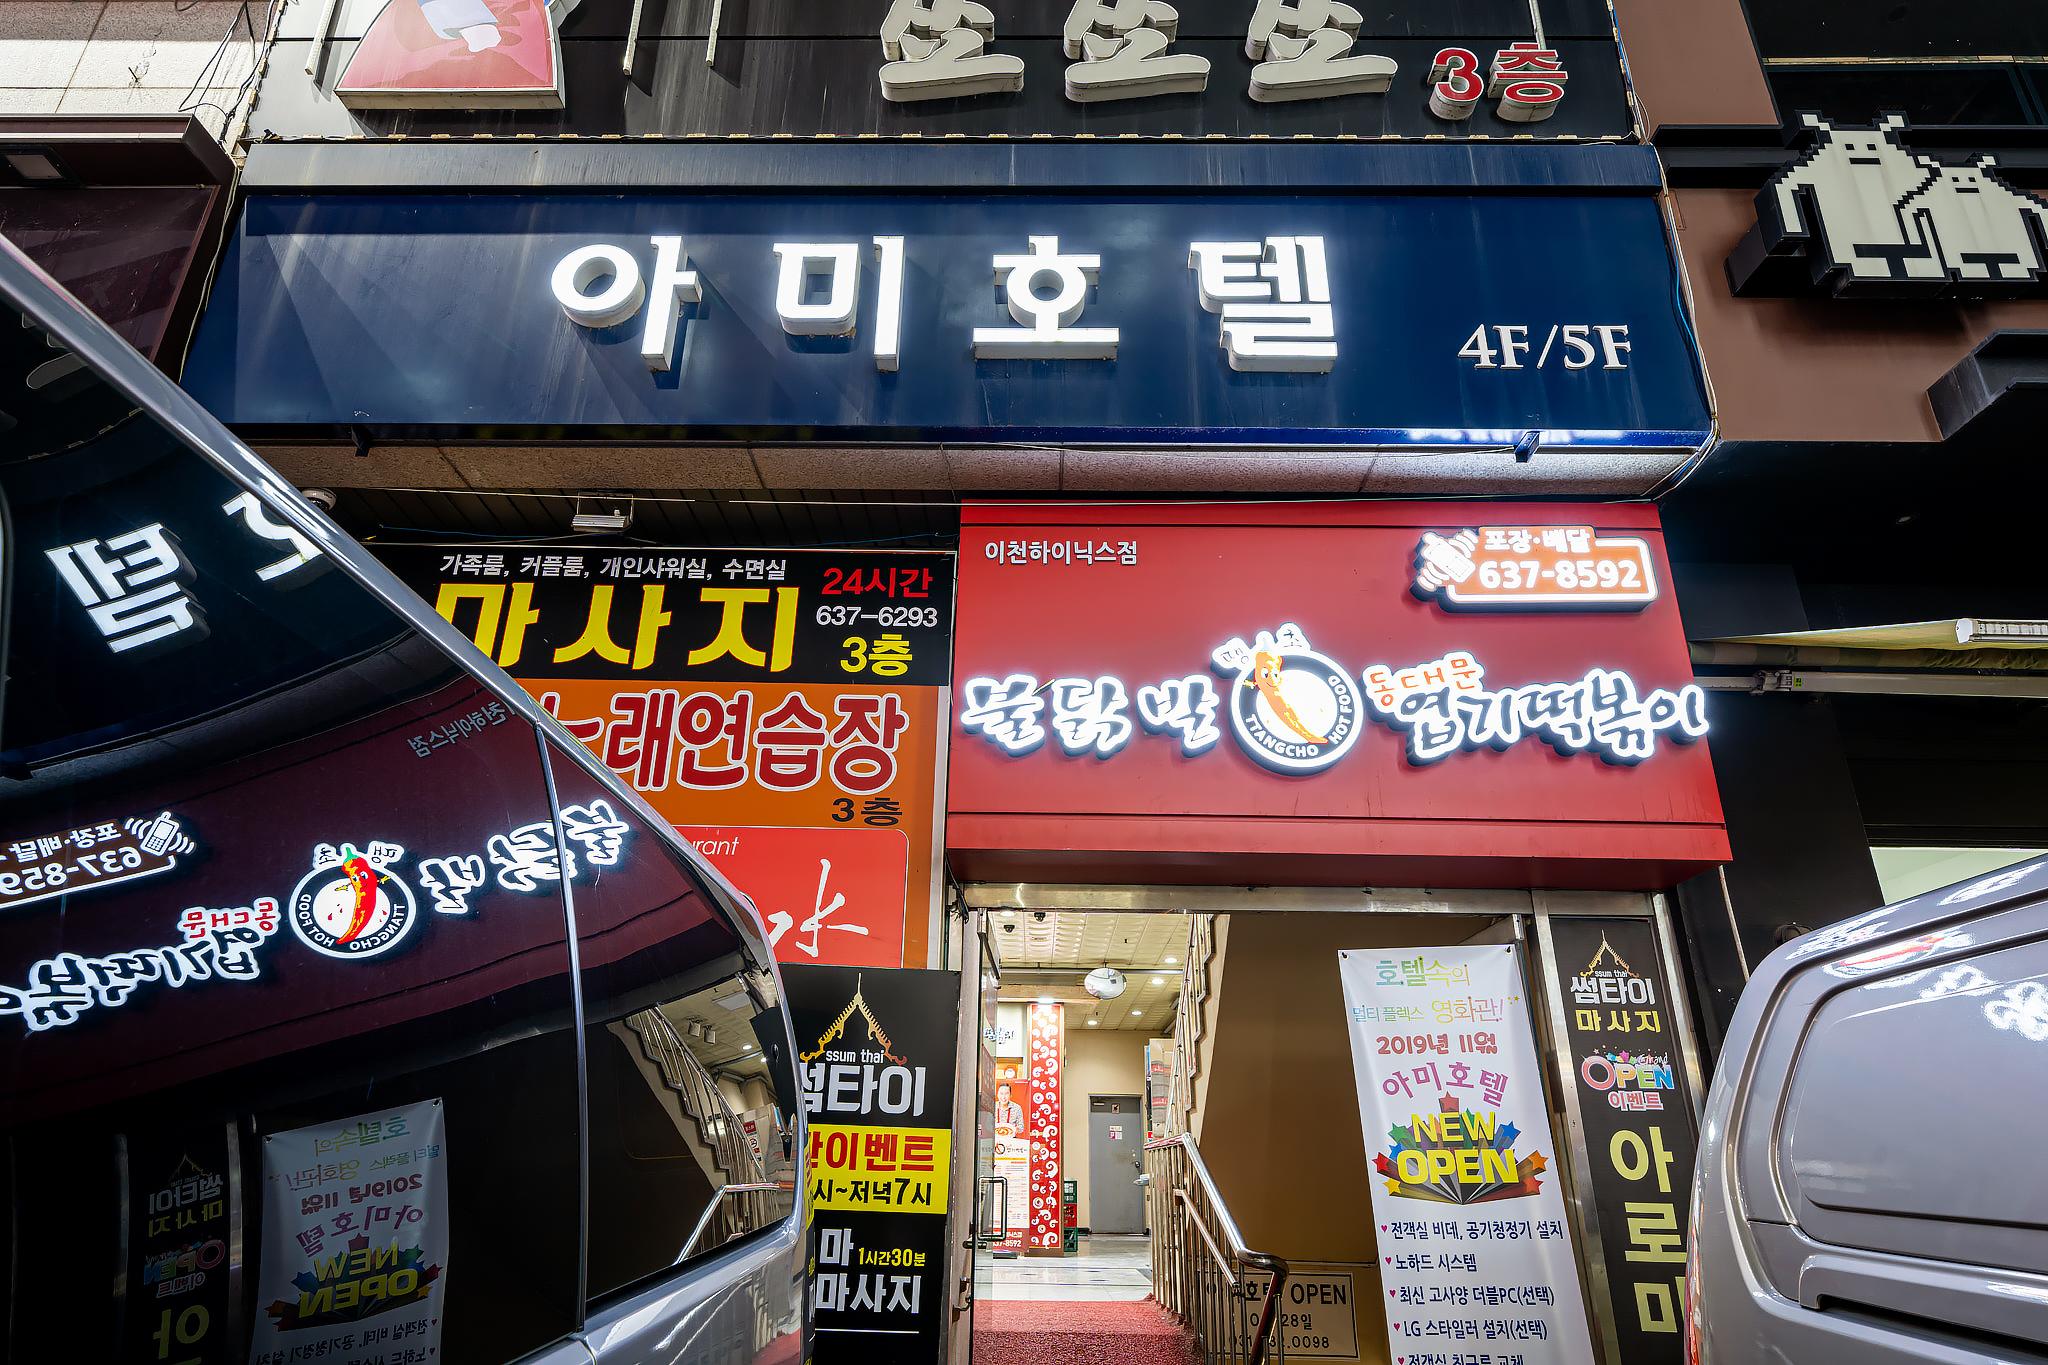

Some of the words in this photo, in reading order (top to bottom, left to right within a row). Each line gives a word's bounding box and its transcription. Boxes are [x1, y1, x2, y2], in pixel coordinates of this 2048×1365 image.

[1428, 42, 1568, 121] 3층
[551, 235, 1338, 373] 아미호텔
[1458, 324, 1632, 370] 4F/5F
[985, 541, 1137, 565] 이천하이닉스점
[1484, 528, 1590, 553] 포장·배달
[440, 554, 510, 577] 가족룸,
[519, 555, 590, 578] 커플룸,
[600, 557, 712, 580] 개인샤워실,
[722, 558, 786, 580] 수면실
[1479, 560, 1641, 588] 637-8592
[822, 567, 933, 598] 24시간
[435, 582, 799, 672] 마사지
[816, 605, 938, 627] 637-6293
[840, 633, 913, 677] 3층
[1328, 675, 1353, 714] FOOD
[1369, 658, 1477, 707] 동대문
[1399, 671, 1706, 756] 엽기떡볶이
[1246, 714, 1319, 758] TTANGCHO
[1329, 716, 1352, 744] HOT
[831, 798, 903, 827] 3층
[1376, 955, 1471, 987] 호텔속의
[1570, 976, 1656, 1005] 썸타이
[1575, 1009, 1661, 1033] 마사지
[825, 1050, 856, 1062] ssum
[860, 1048, 885, 1063] thai
[1376, 1033, 1449, 1055] 2019년
[1382, 1061, 1509, 1108] 아미호텔
[1581, 1055, 1674, 1091] OPEN
[1608, 1090, 1664, 1111] 이벤트
[1411, 1112, 1496, 1144] NEW
[1396, 1149, 1520, 1185] OPEN
[1391, 1221, 1428, 1240] 전객실
[1432, 1221, 1463, 1240] 비데,
[1466, 1220, 1532, 1240] 공기청정기
[1536, 1220, 1564, 1240] 설치
[858, 1247, 926, 1267] 1시간30분
[1395, 1254, 1434, 1272] 노하드
[1438, 1253, 1478, 1273] 시스템
[815, 1273, 922, 1314] 마사지
[1290, 1284, 1347, 1305] OPEN
[1400, 1286, 1425, 1305] 최신
[1429, 1286, 1468, 1305] 고사양
[1472, 1286, 1555, 1306] 더블PC(선택)
[1404, 1321, 1421, 1337] LG
[1425, 1319, 1479, 1339] 스타일러
[1483, 1320, 1548, 1340] 설치(선택)
